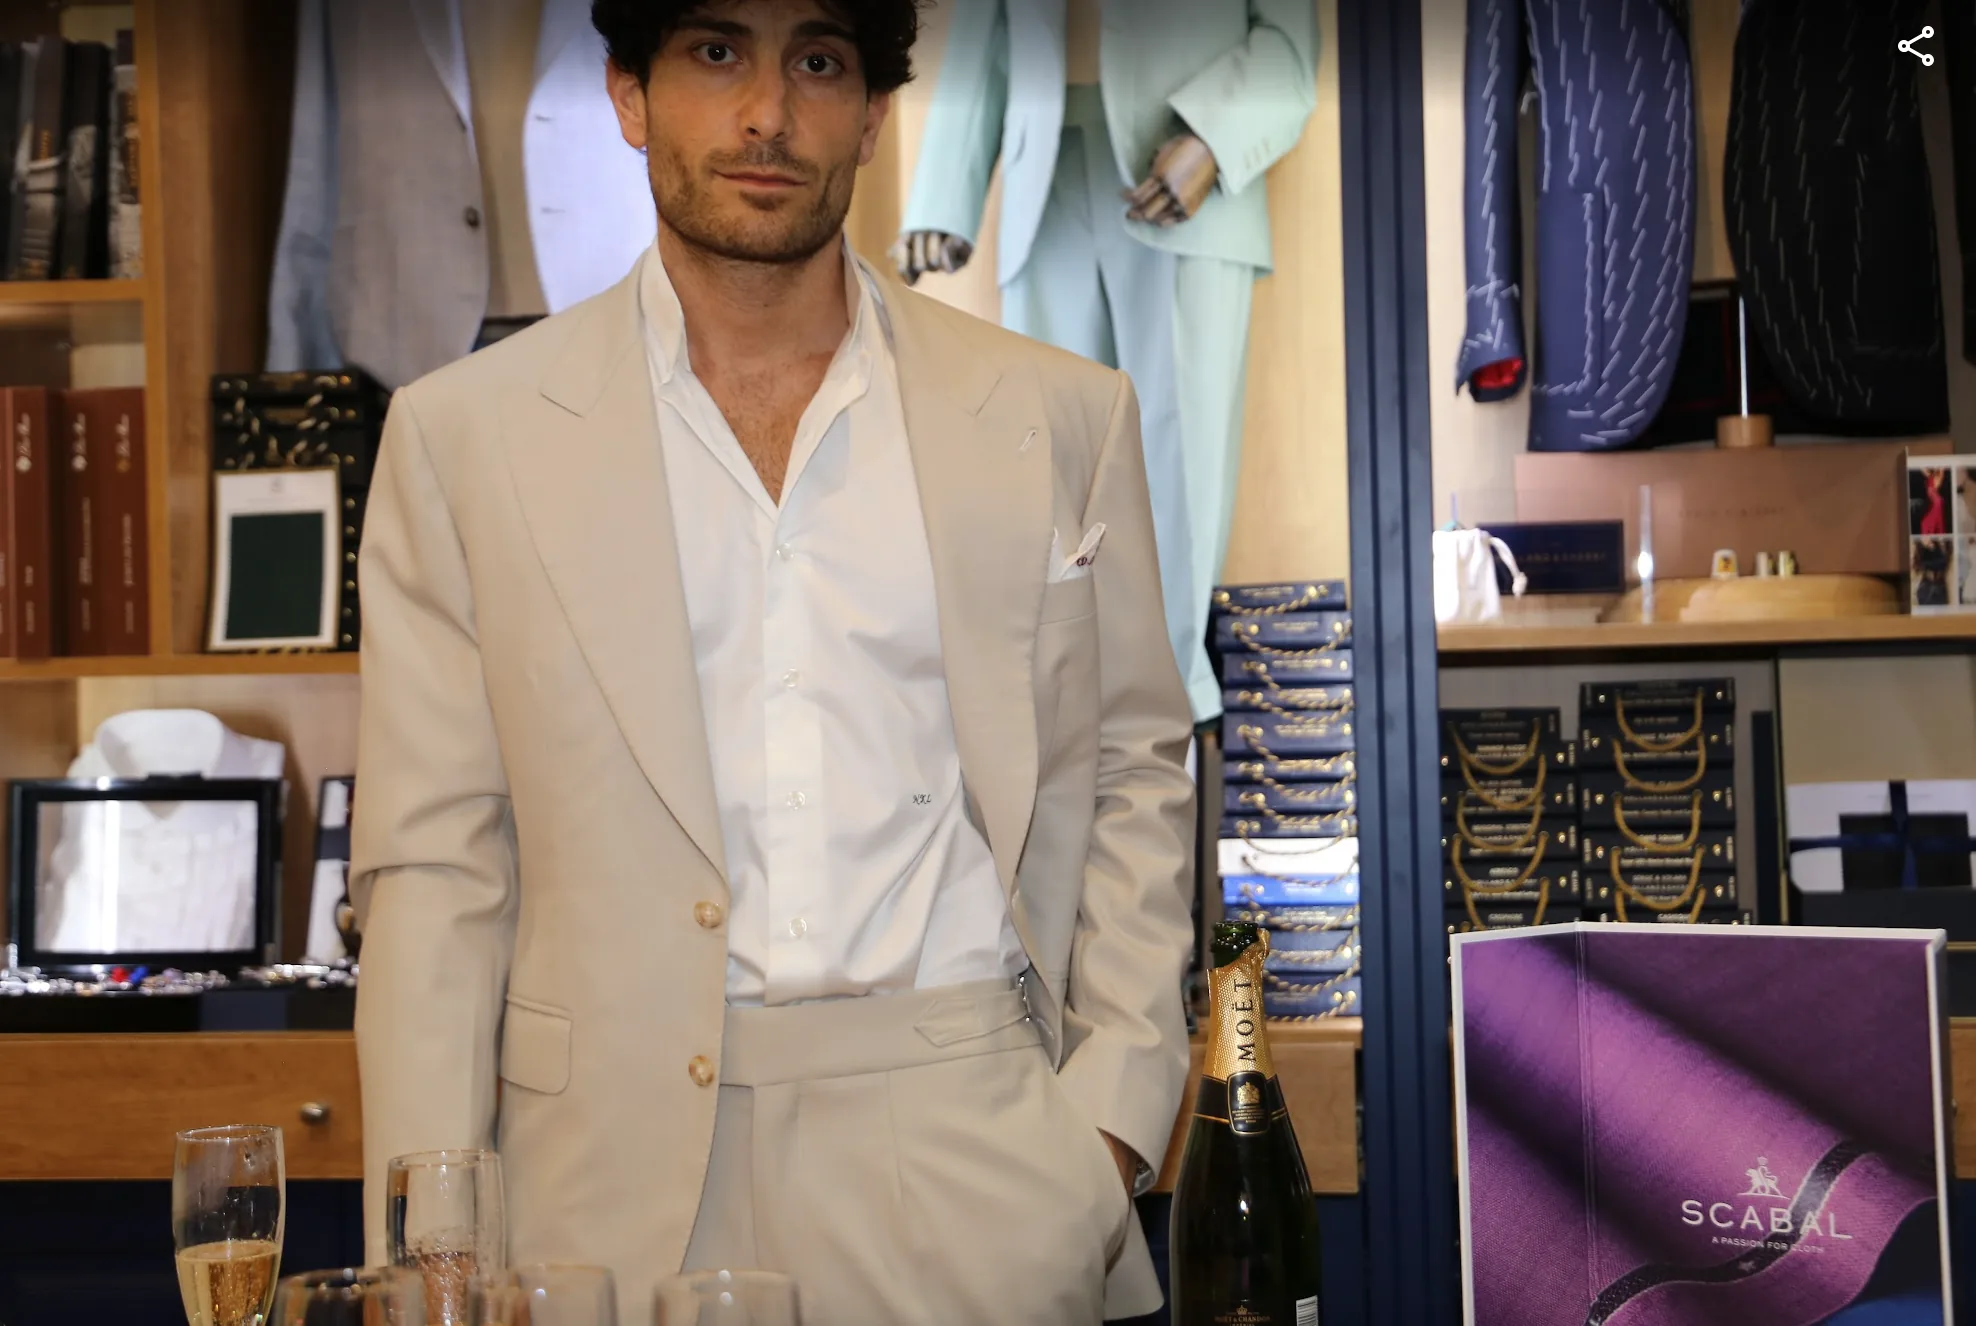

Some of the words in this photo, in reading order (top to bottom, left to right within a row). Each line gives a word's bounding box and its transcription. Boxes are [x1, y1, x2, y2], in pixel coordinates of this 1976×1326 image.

[1232, 979, 1256, 1061] MOËT
[1681, 1199, 1853, 1240] SCABAL
[1711, 1236, 1719, 1244] A
[1721, 1236, 1764, 1248] PASSION
[1766, 1241, 1788, 1250] FOR
